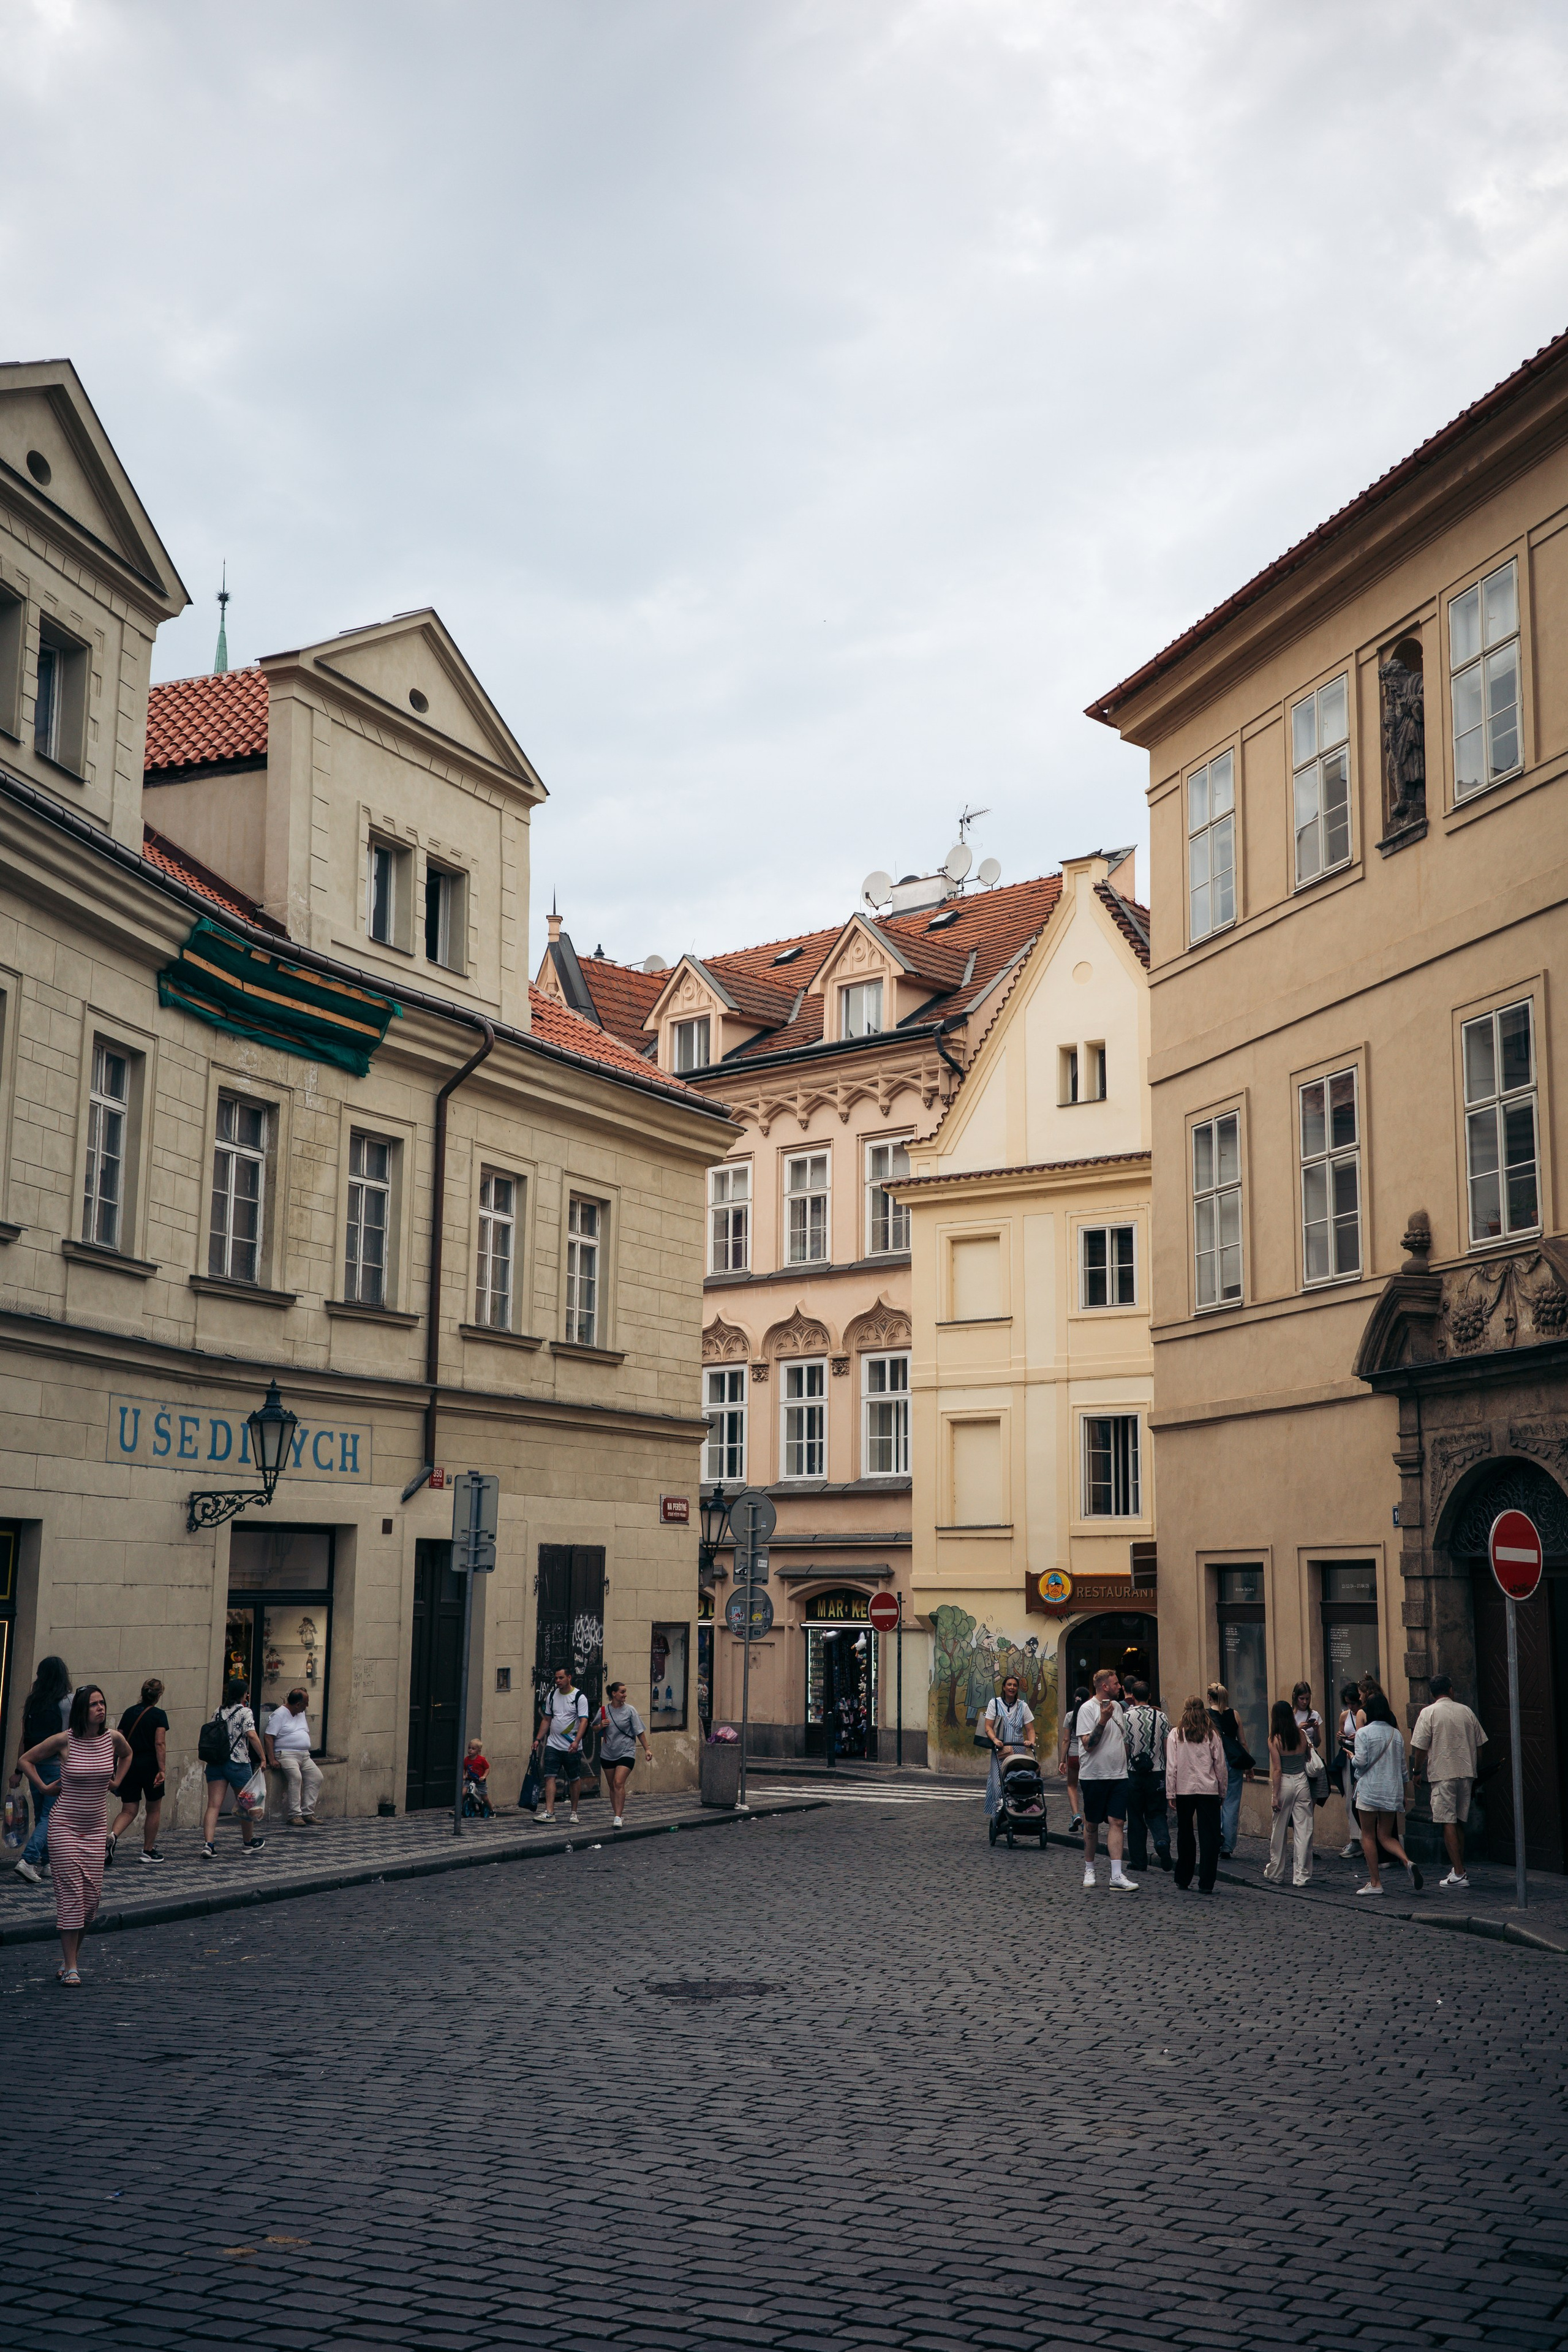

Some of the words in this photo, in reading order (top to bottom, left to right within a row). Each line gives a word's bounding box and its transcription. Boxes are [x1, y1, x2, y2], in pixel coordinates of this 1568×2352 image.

[119, 1406, 141, 1453] U
[153, 1404, 360, 1473] ŠEDIÝCH
[433, 1469, 442, 1478] 350
